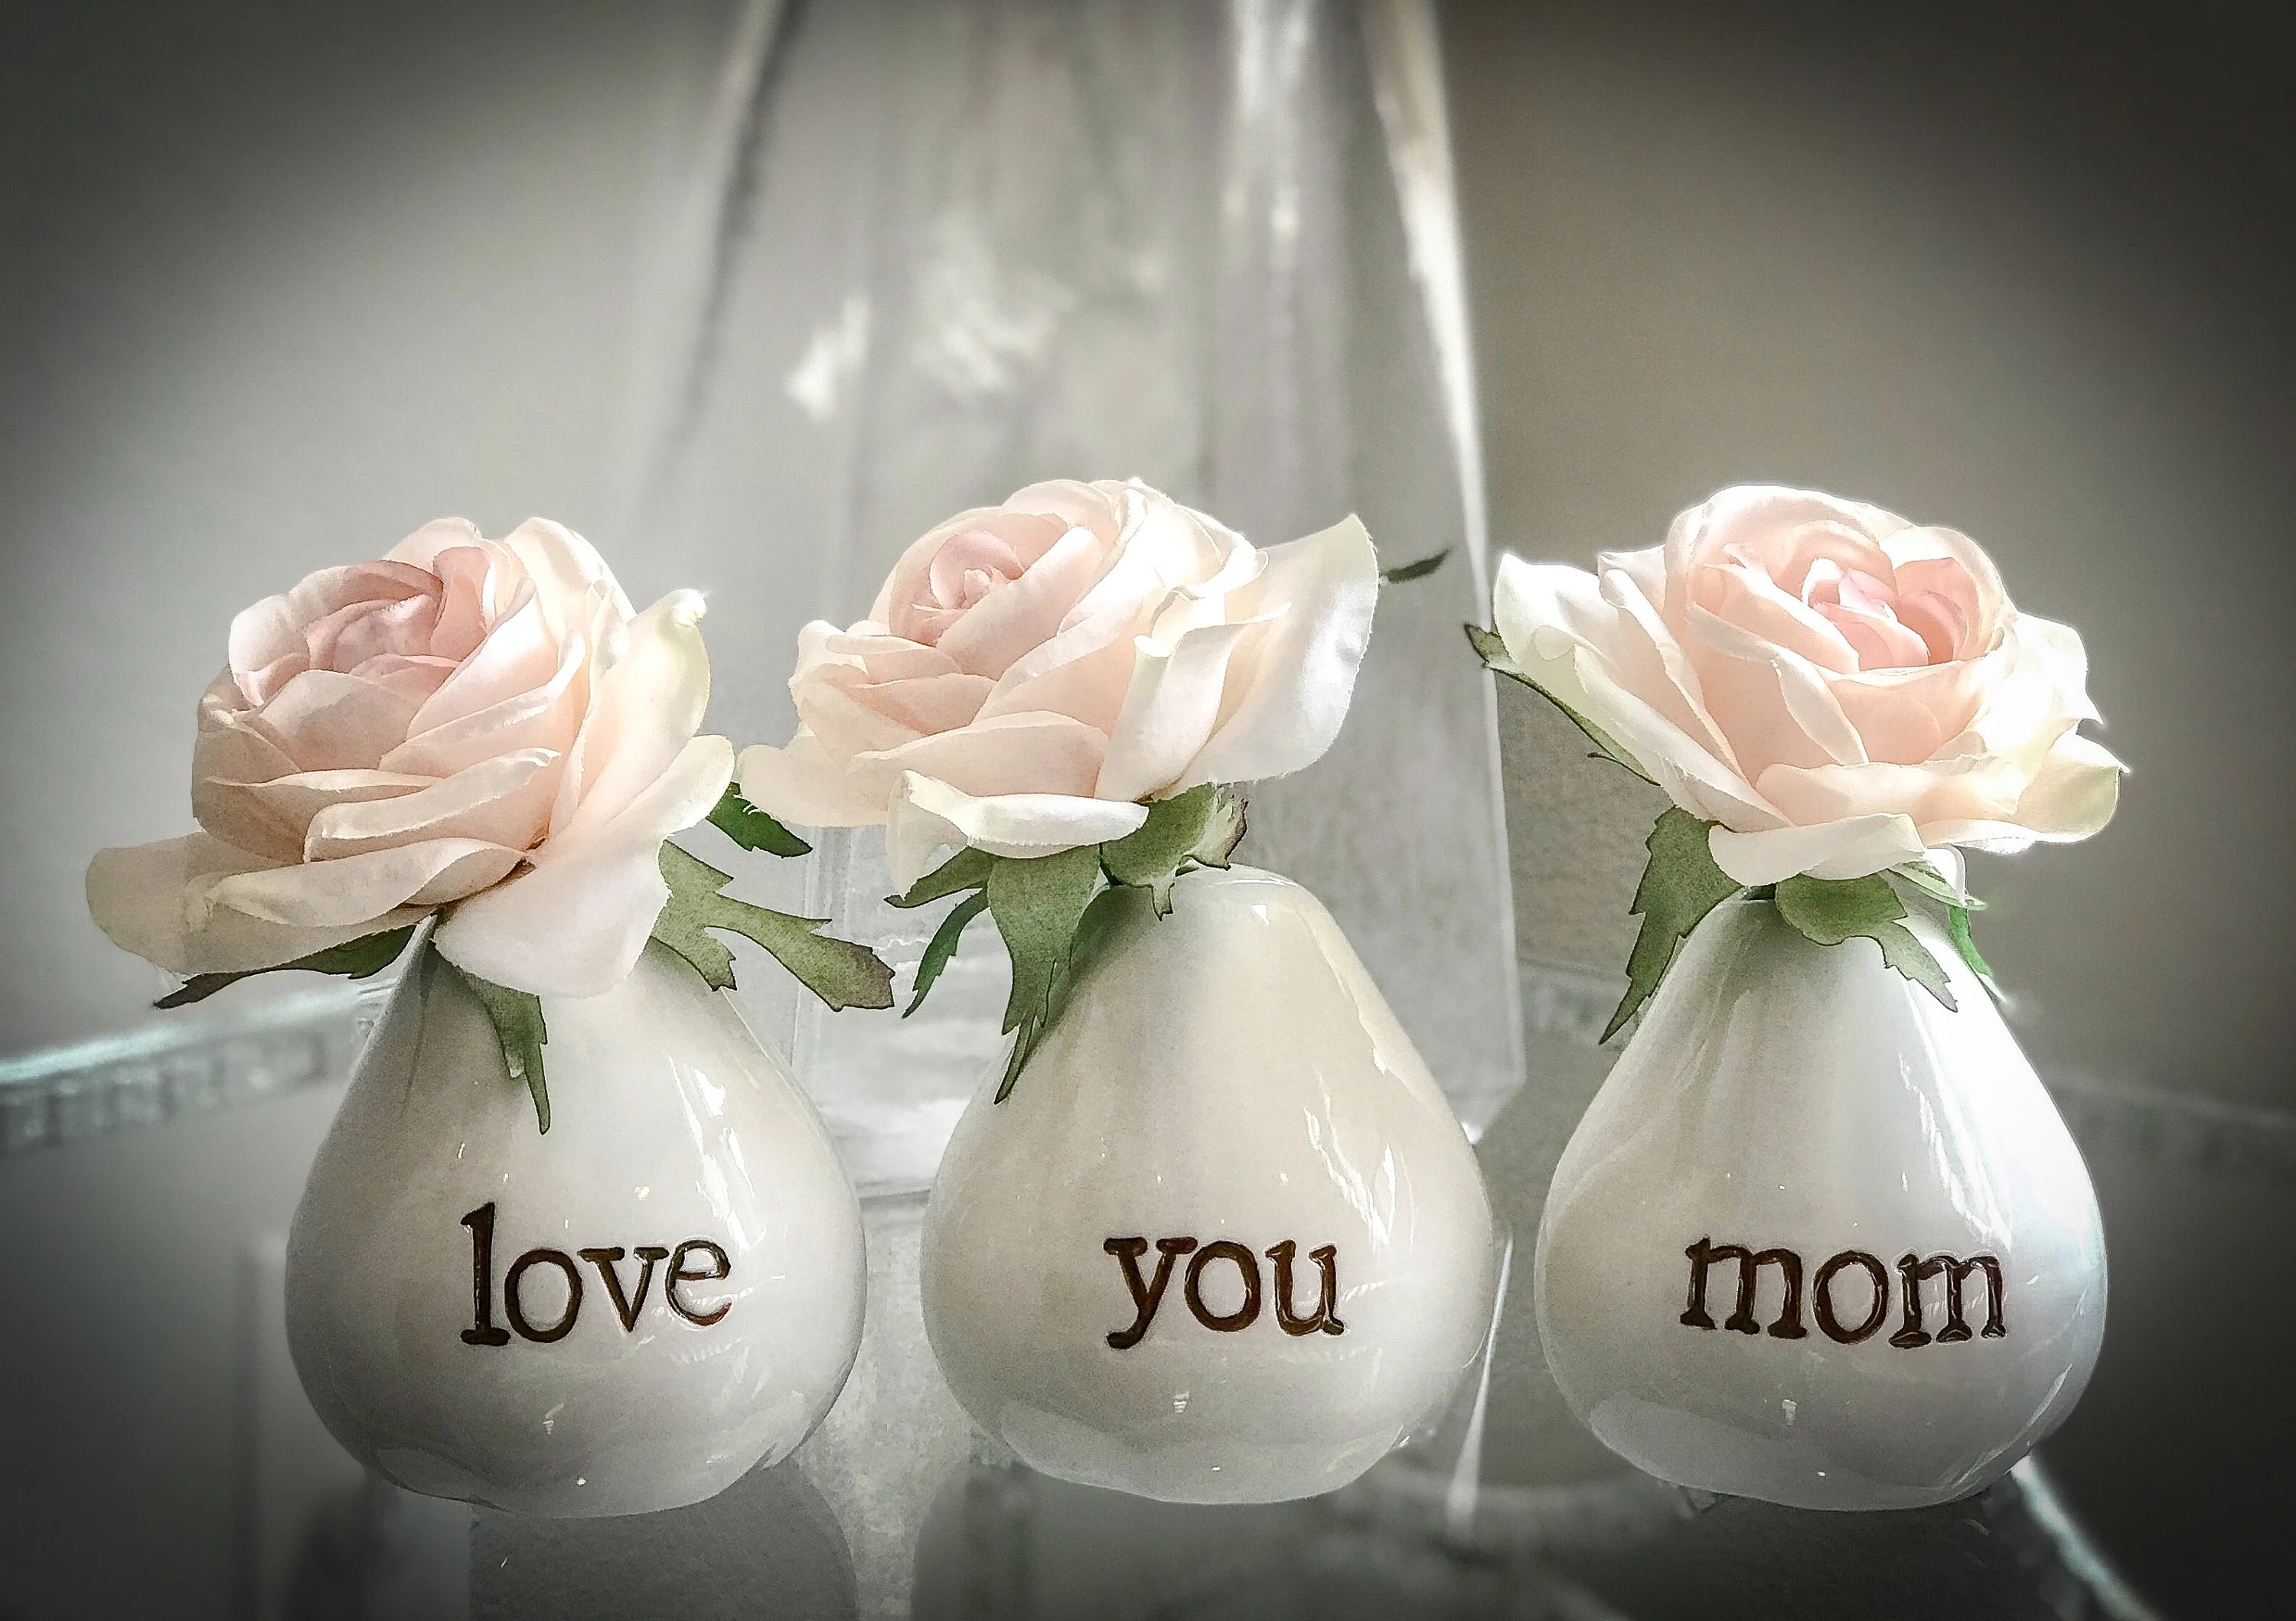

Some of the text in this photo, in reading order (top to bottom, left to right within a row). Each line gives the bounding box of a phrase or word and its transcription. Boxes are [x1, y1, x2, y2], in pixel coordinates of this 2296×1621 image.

[459, 1201, 732, 1347] love
[1103, 1236, 1345, 1351] you
[1679, 1235, 2008, 1349] mom
